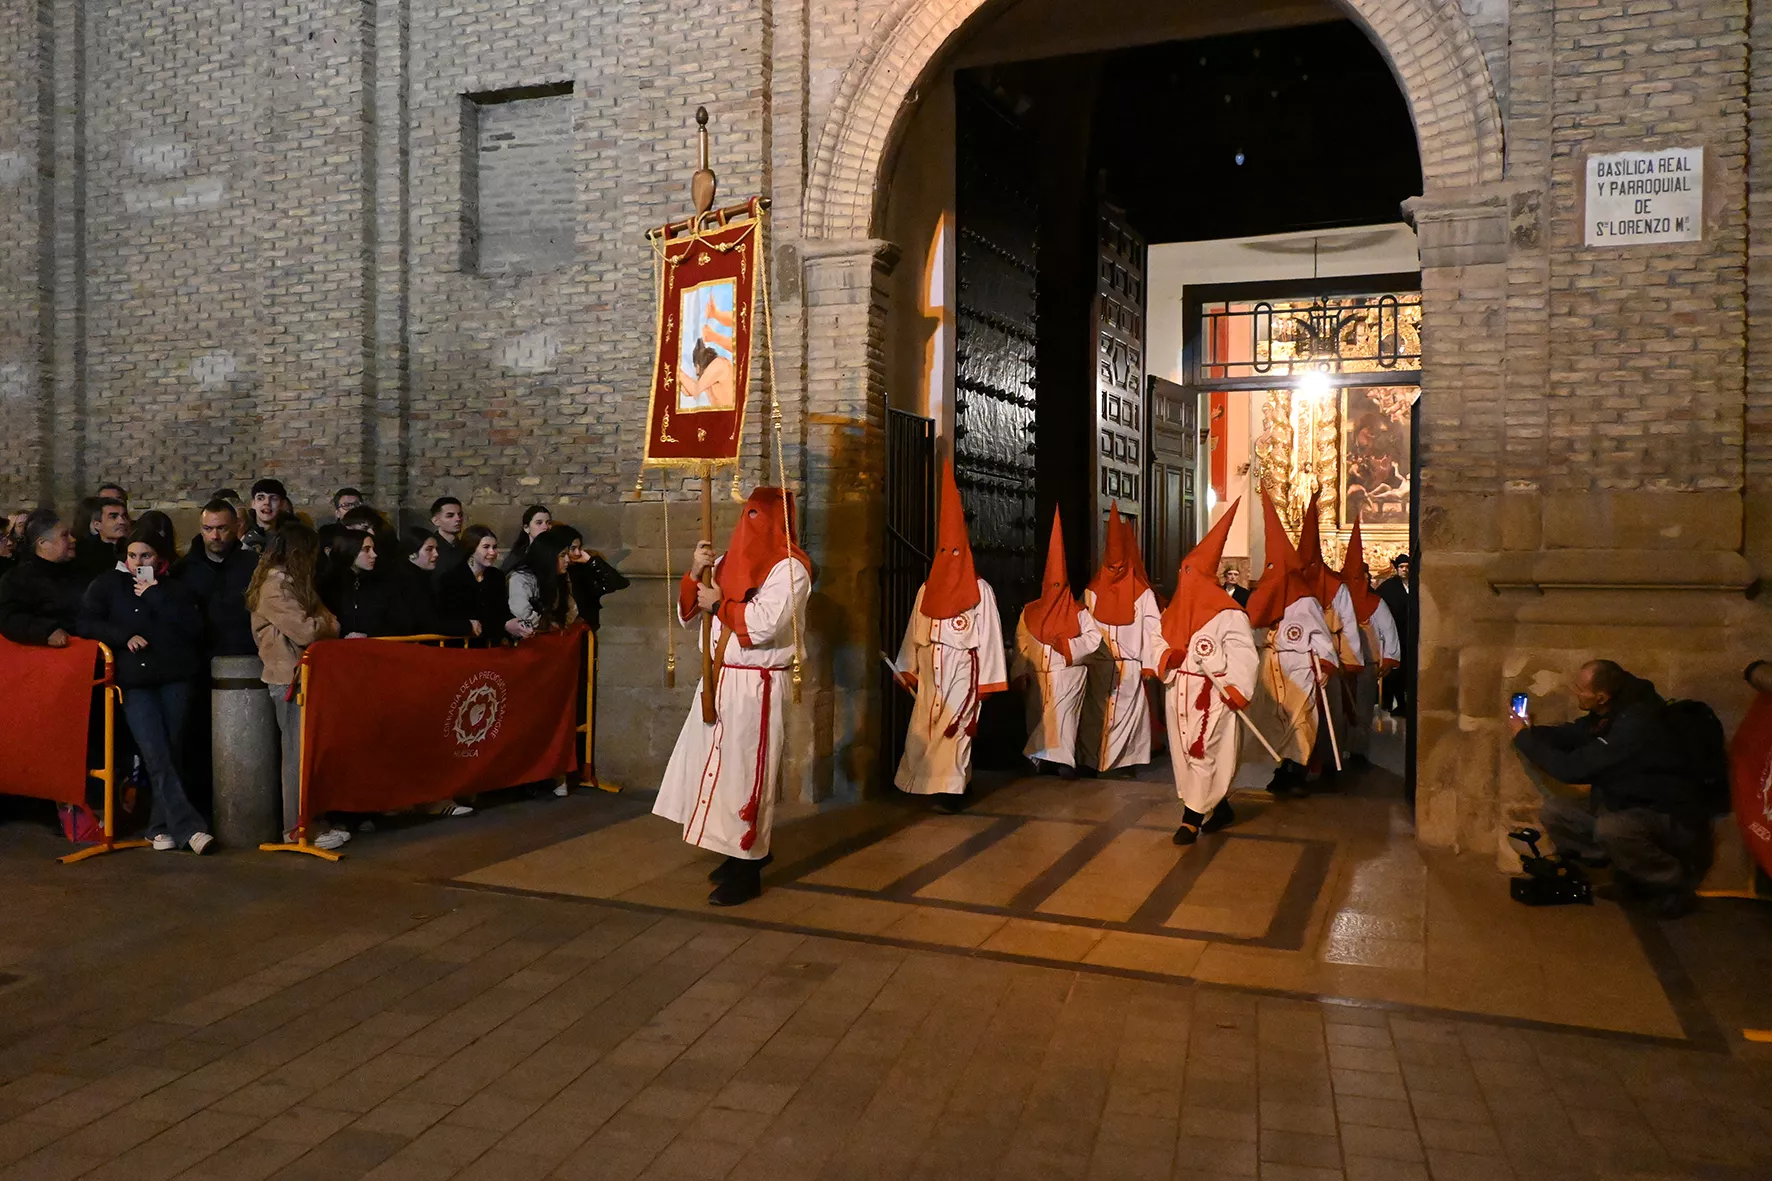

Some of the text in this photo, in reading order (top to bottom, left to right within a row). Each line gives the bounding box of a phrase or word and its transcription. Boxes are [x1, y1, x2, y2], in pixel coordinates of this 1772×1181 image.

[1597, 156, 1691, 178] BASÍLICA REAL
[1597, 176, 1691, 196] Y PARROQUIAL
[1634, 198, 1652, 214] DE
[1609, 217, 1670, 236] LORENZO
